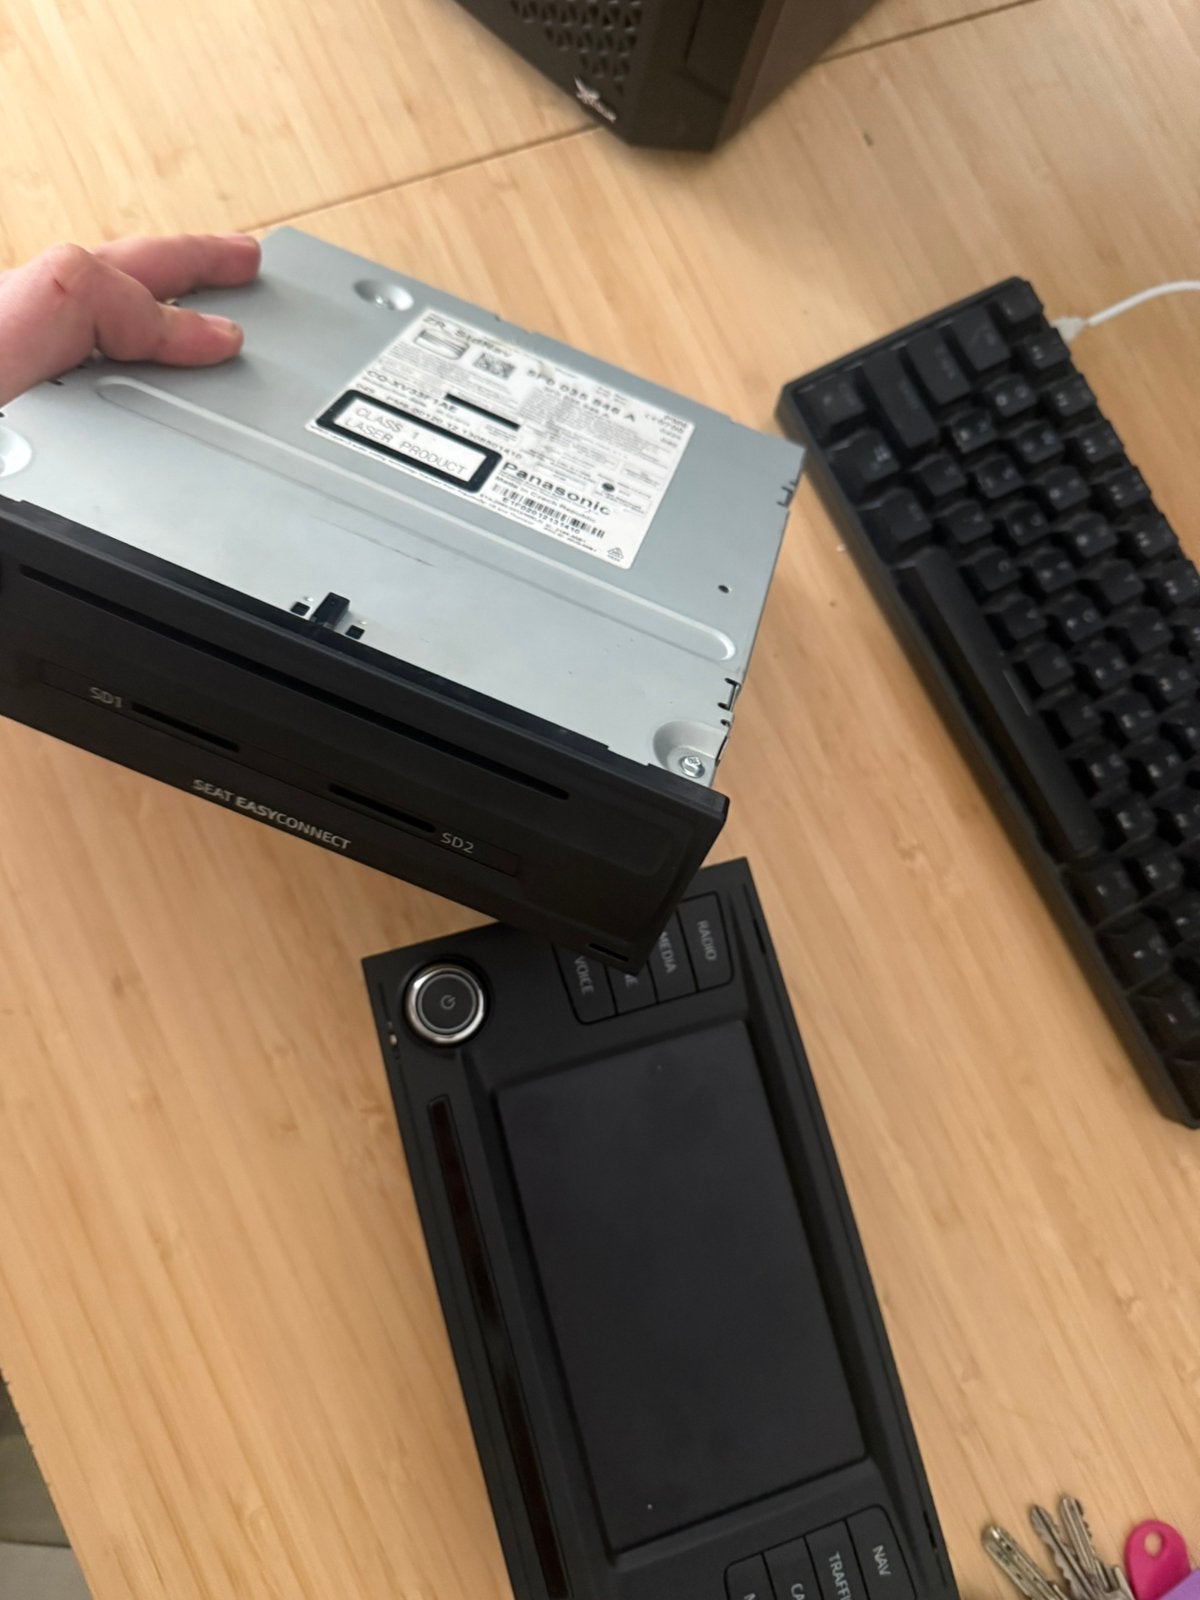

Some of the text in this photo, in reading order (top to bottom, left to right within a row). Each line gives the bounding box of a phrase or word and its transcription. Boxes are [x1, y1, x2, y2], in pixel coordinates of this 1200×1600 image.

[354, 407, 421, 439] CLASS 1
[624, 412, 637, 422] A
[343, 417, 467, 475] LASER PRODUCT
[500, 461, 612, 516] Panasonic
[90, 686, 122, 708] SD1
[193, 779, 351, 849] SEAT EASYCONNECT
[440, 831, 475, 854] SD2
[697, 920, 718, 961] RADIO
[574, 955, 595, 995] VOICE
[872, 1545, 892, 1576] NAV
